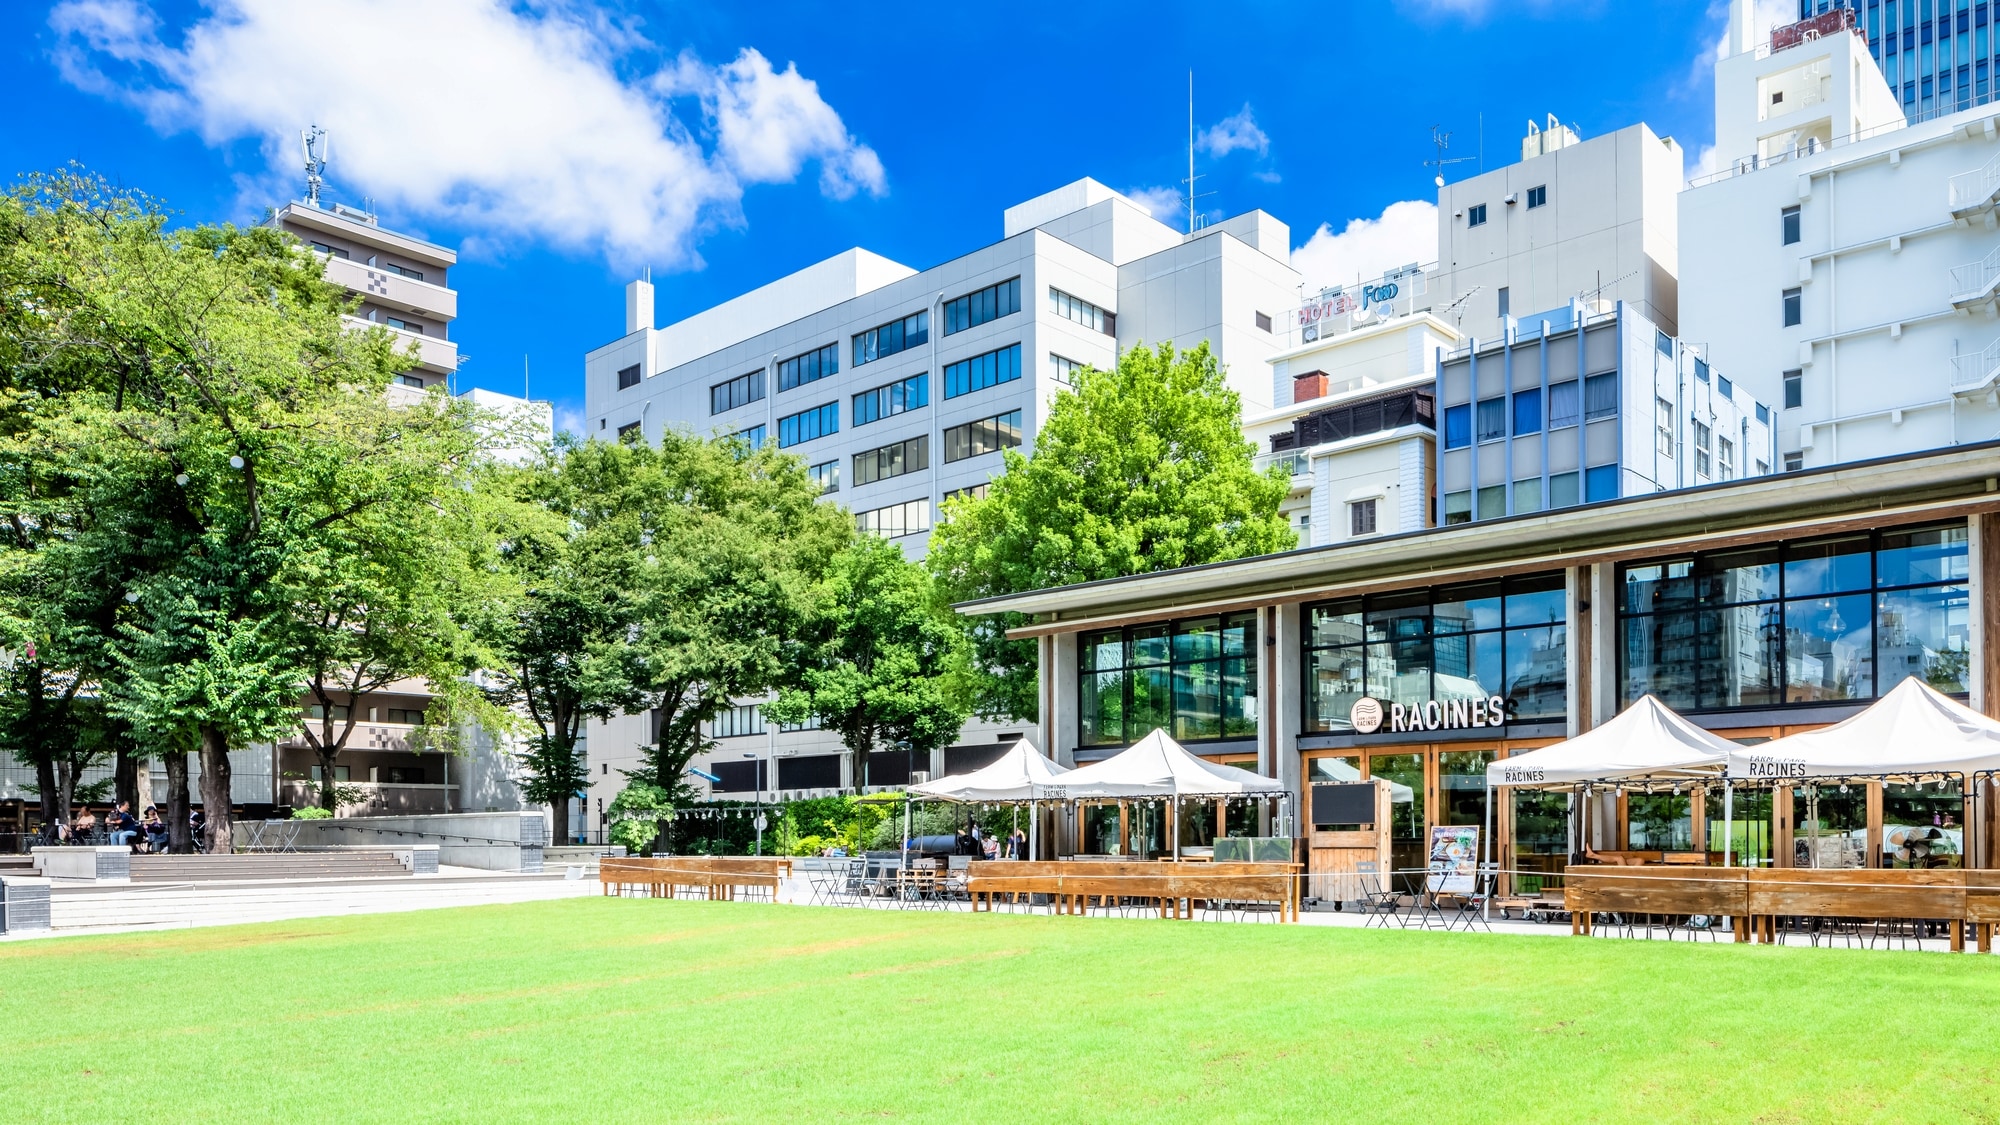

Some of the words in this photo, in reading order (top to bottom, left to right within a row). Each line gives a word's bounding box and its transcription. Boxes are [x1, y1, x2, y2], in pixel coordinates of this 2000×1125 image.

[1298, 296, 1357, 325] HOTEL
[1391, 695, 1504, 733] RACINES
[1356, 719, 1377, 727] RACINES
[1749, 762, 1806, 776] RACINES
[1505, 770, 1544, 782] RACINES
[1043, 789, 1067, 798] RACINES
